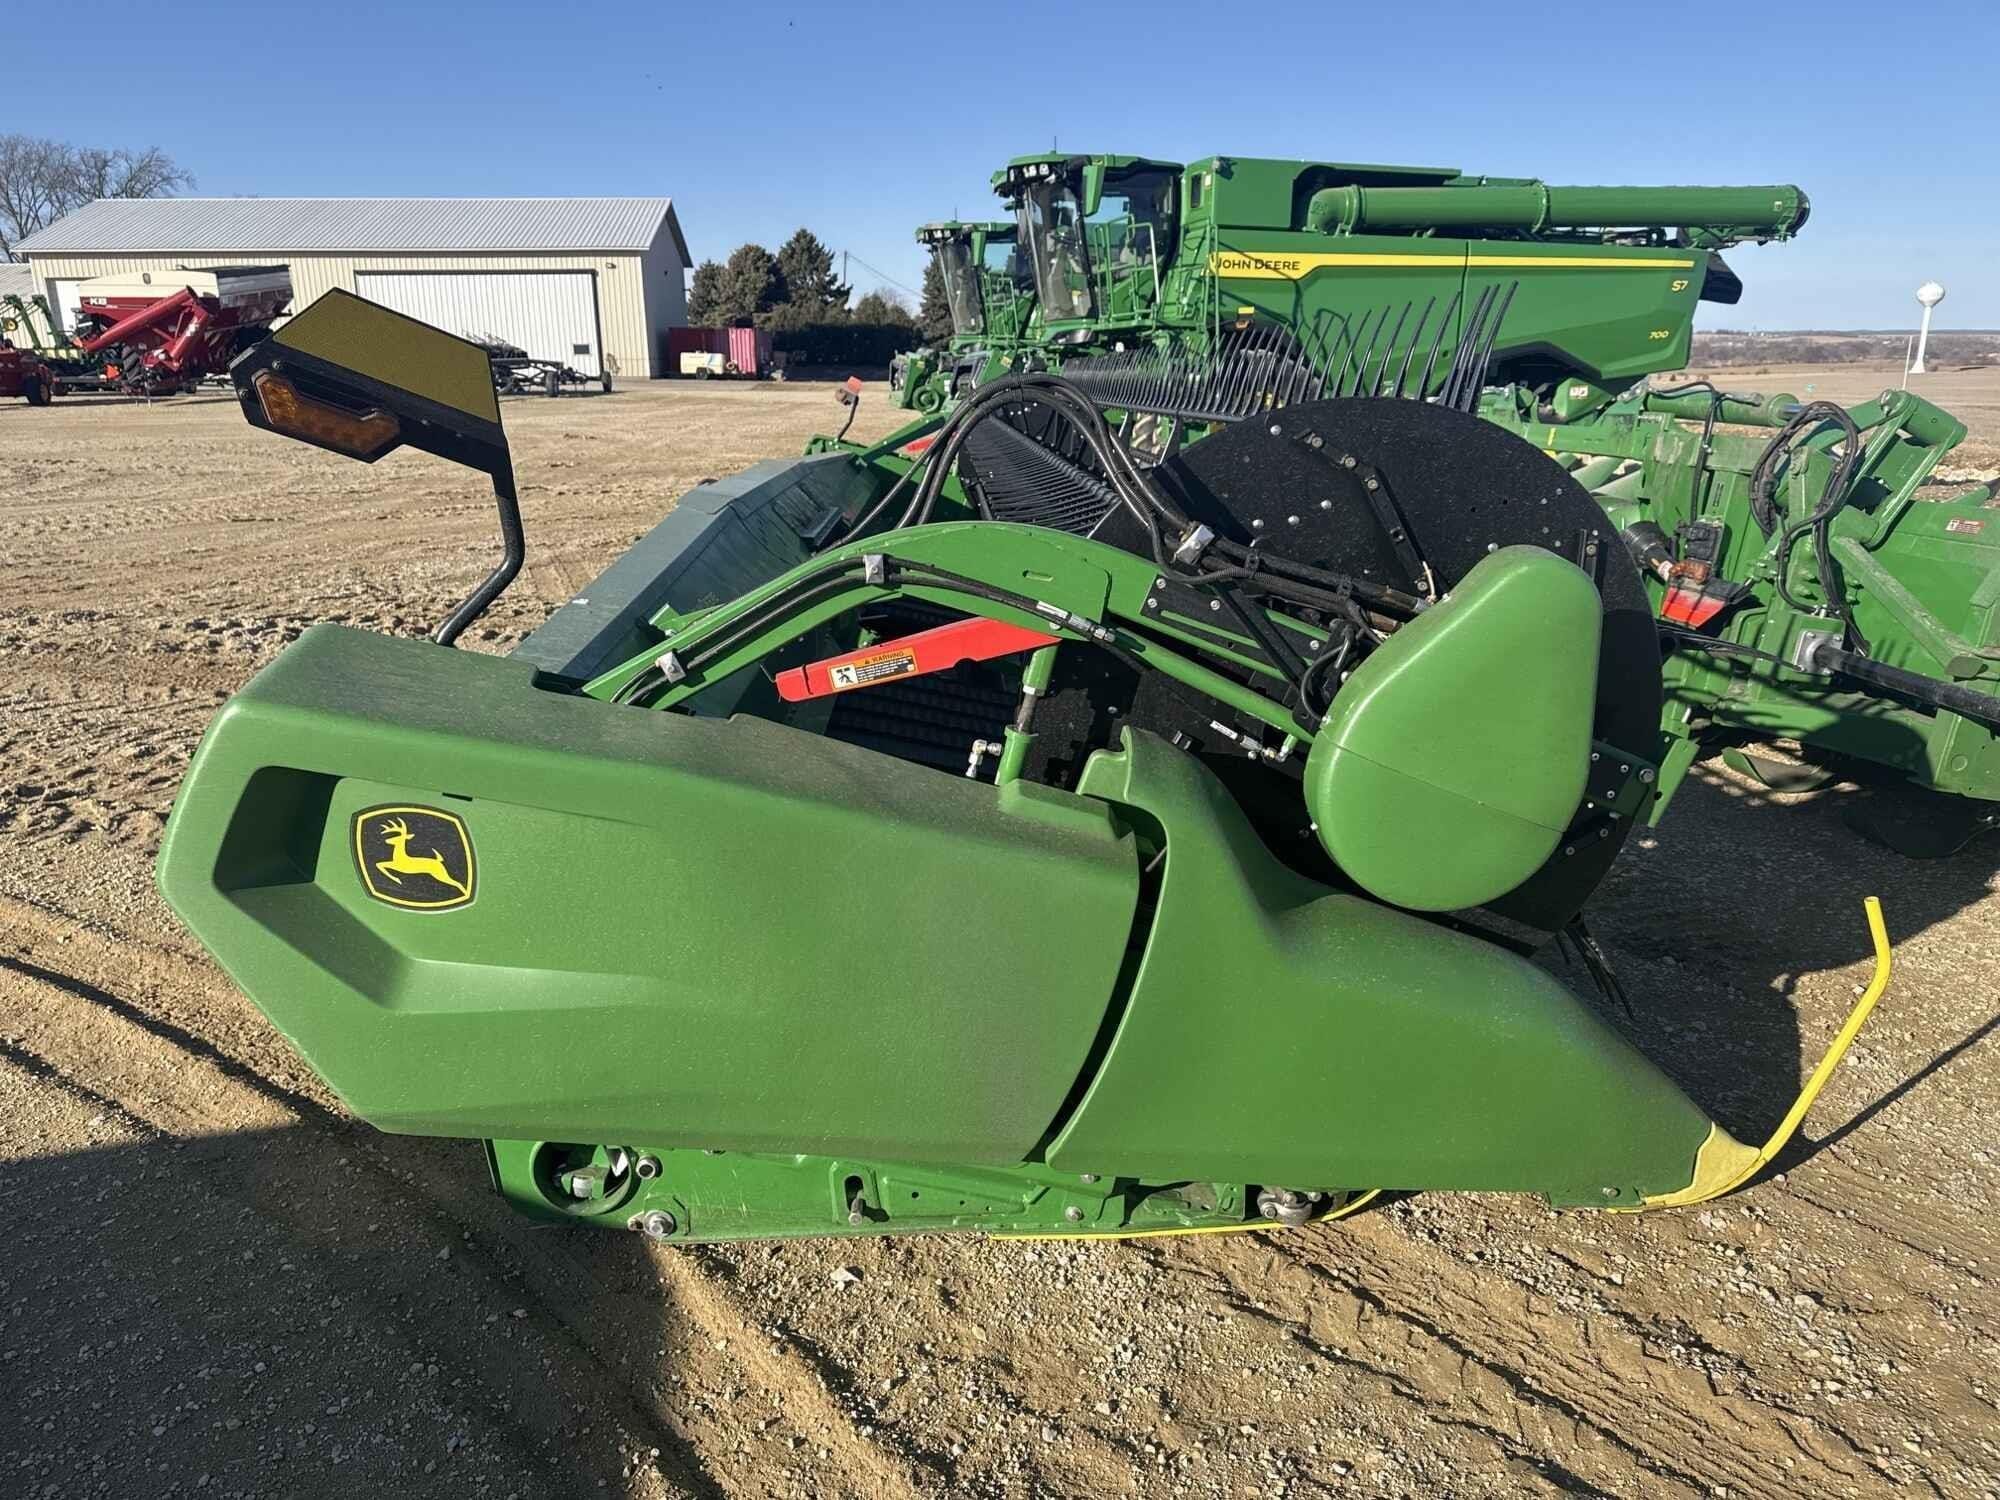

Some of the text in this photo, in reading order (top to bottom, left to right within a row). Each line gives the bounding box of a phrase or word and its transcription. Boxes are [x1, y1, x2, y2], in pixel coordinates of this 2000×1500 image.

[1216, 257, 1300, 270] JOHN DEERE
[1671, 280, 1689, 292] S7
[1649, 330, 1670, 339] 700
[871, 650, 905, 662] WARNING
